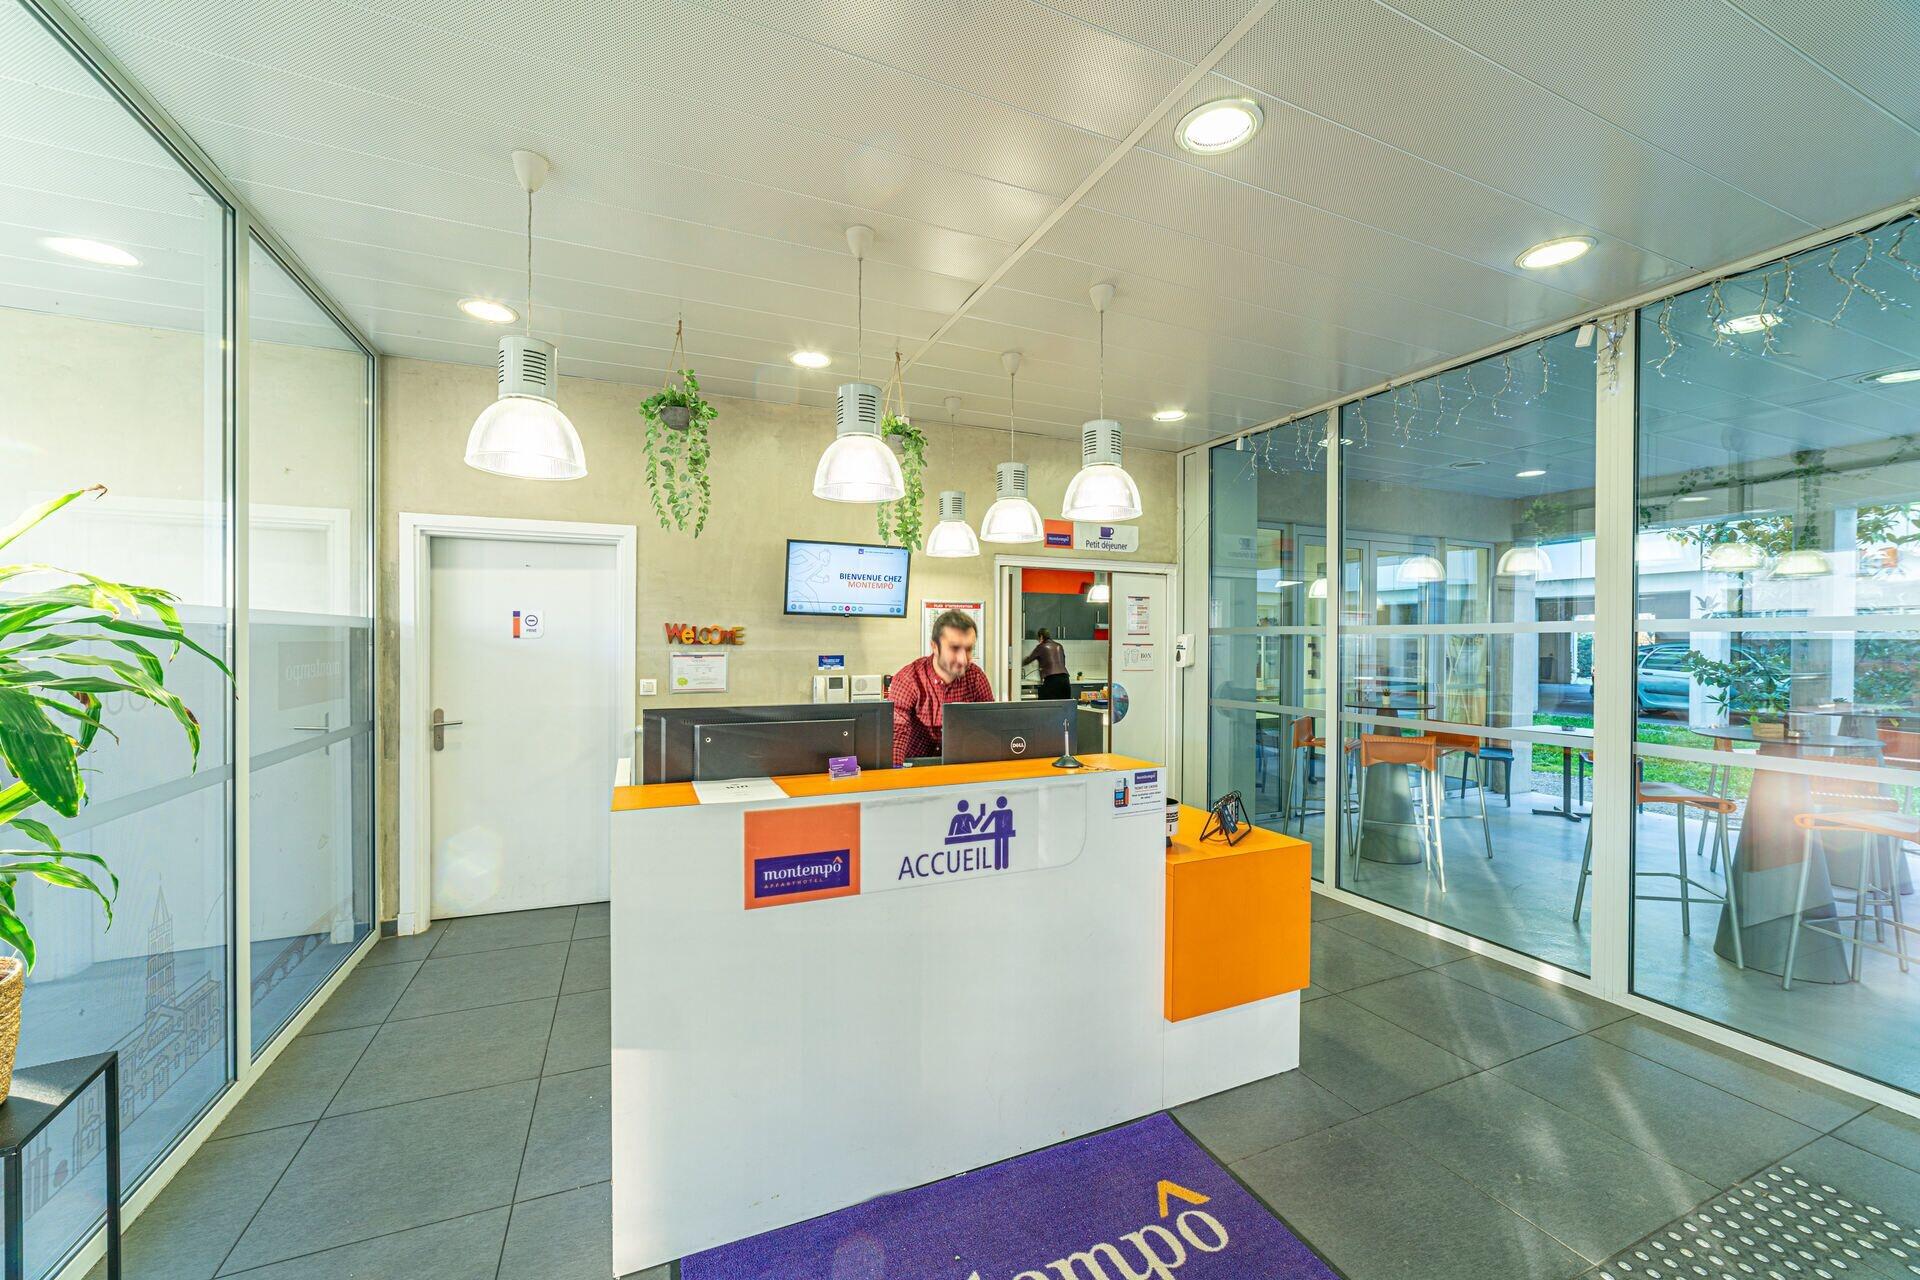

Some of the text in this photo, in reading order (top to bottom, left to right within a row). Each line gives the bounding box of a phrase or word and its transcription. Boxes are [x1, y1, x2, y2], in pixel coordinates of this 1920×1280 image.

[1085, 539, 1128, 551] Petit déjeuner
[839, 572, 882, 581] BIENVENUE
[847, 581, 894, 589] MONTEMPÔ
[763, 856, 843, 881] montempô
[898, 846, 992, 880] ACCUEIL
